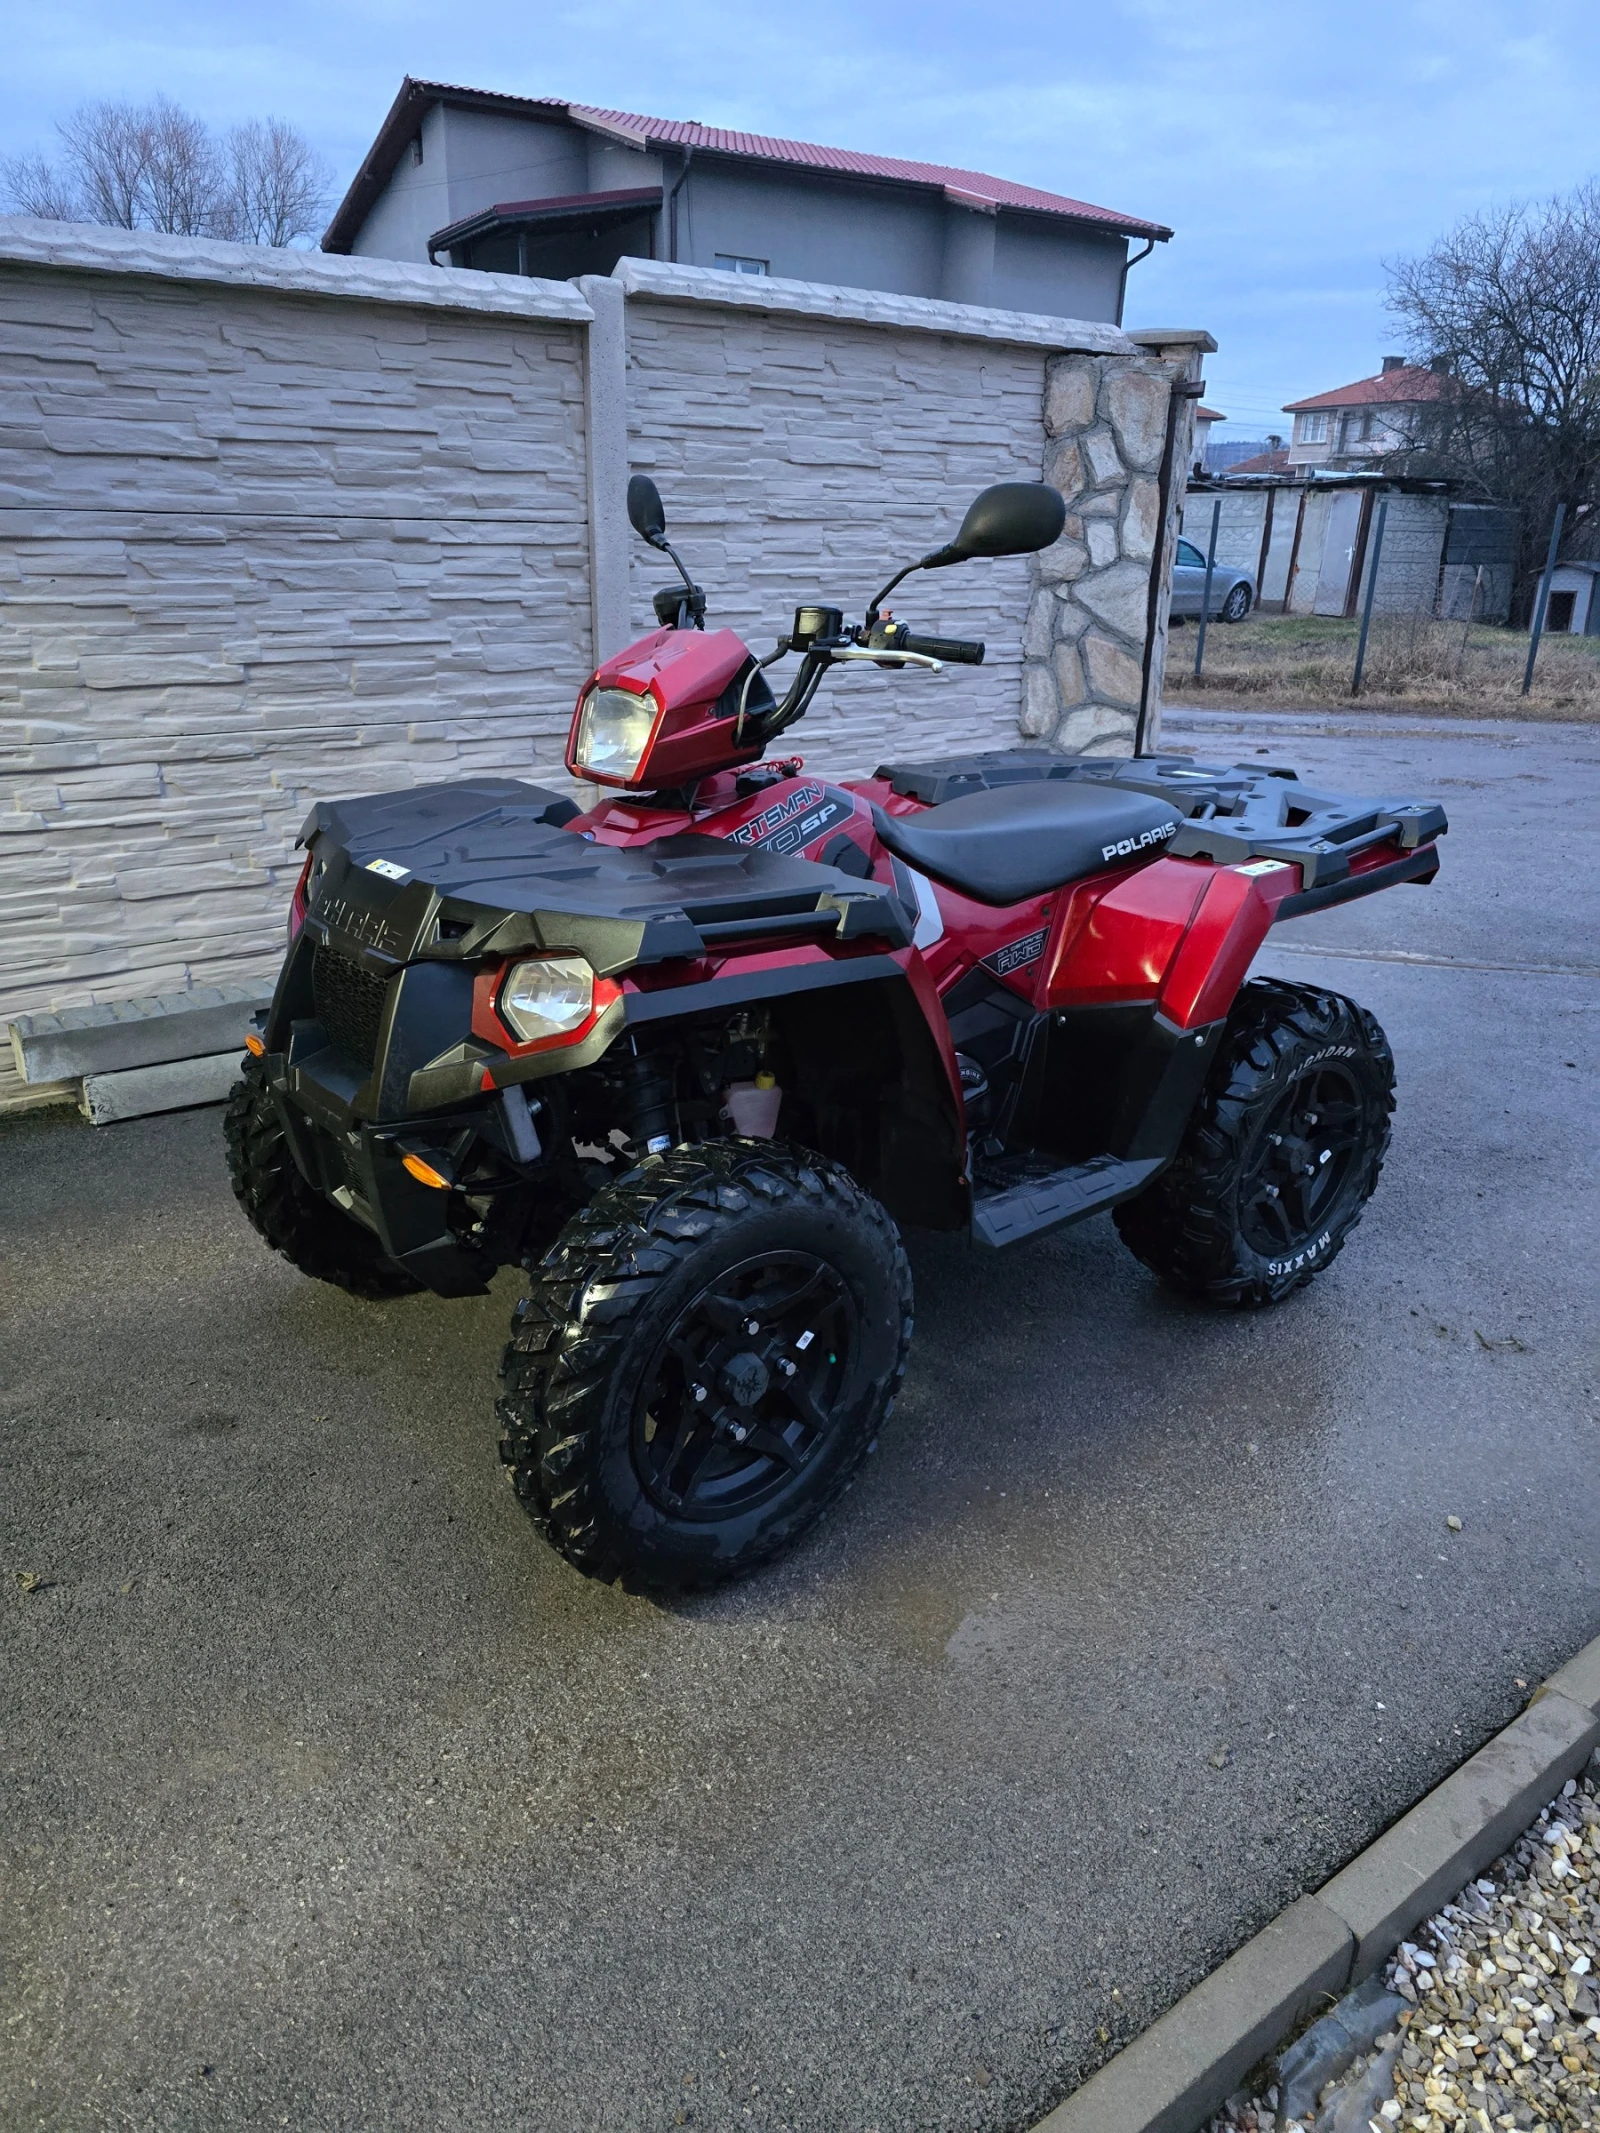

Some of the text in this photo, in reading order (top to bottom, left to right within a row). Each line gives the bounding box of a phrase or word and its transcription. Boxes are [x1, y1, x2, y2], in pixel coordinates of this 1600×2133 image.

[801, 803, 838, 835] SP
[1101, 821, 1177, 861] POLARIS
[997, 939, 1044, 973] AWD
[960, 1069, 981, 1080] NGINE
[1267, 1230, 1331, 1276] MAXXIS
